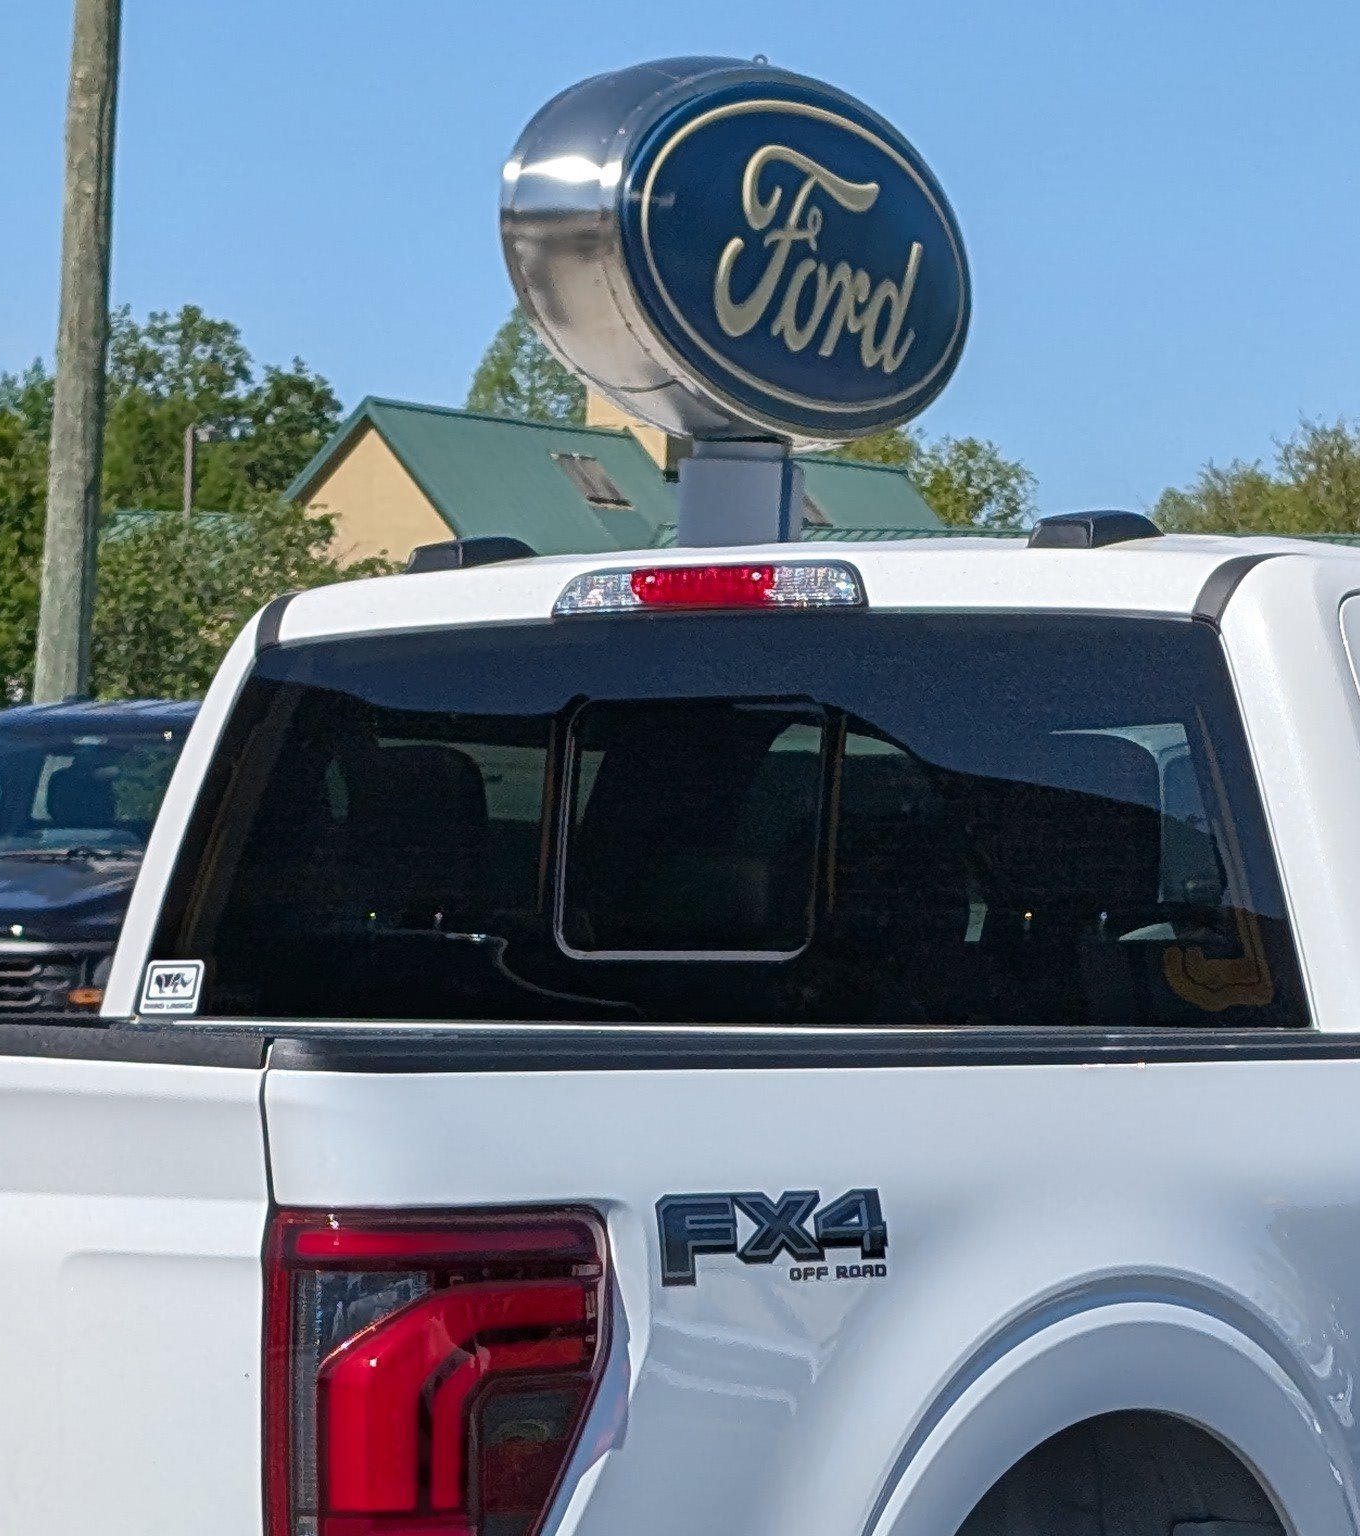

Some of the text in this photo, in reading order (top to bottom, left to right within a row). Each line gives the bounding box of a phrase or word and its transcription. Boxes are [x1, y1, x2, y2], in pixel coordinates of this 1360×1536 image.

[714, 144, 923, 374] Ford
[654, 1187, 888, 1287] FX4
[789, 1263, 888, 1282] OFF ROAD
